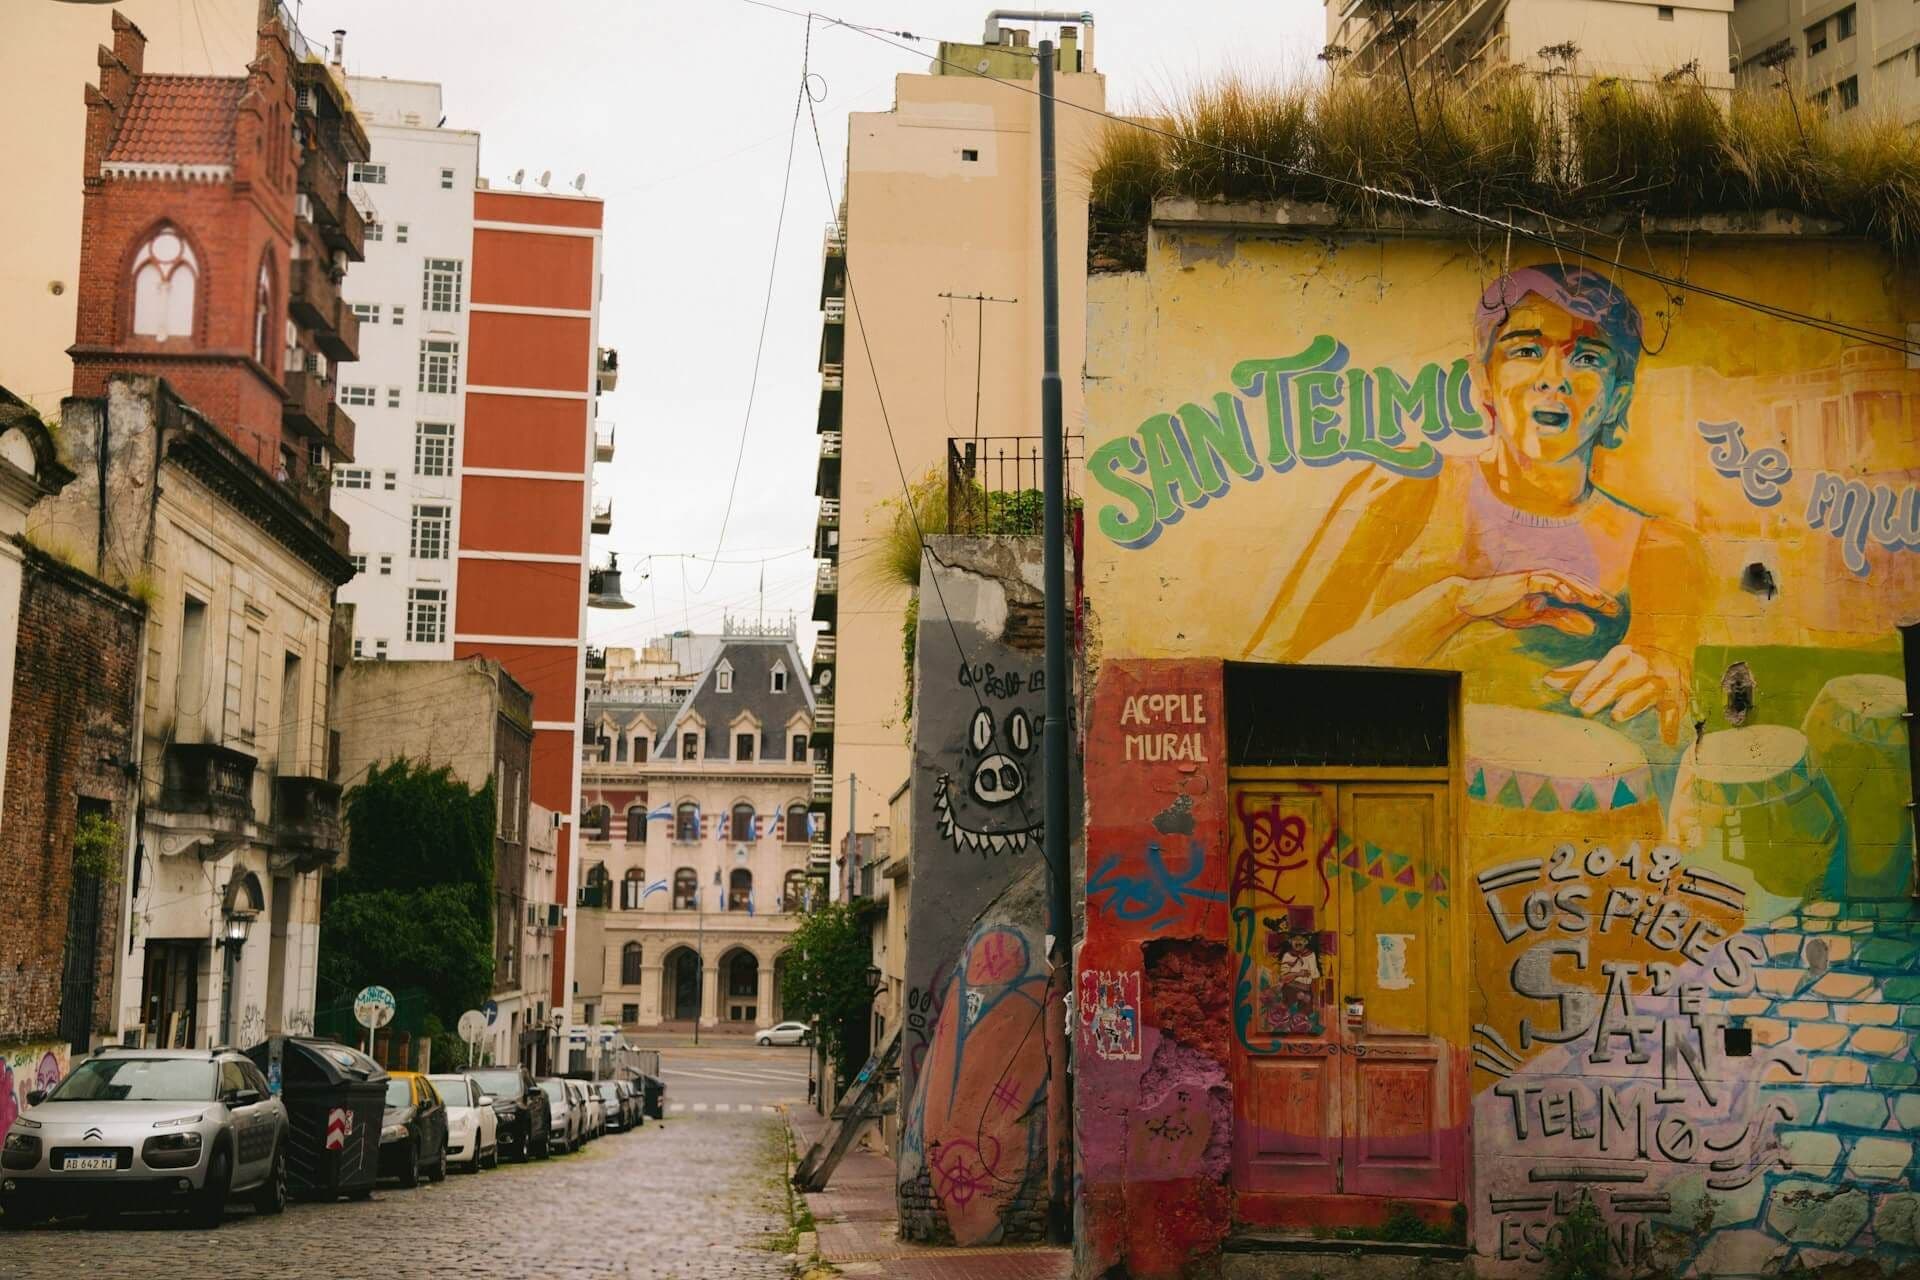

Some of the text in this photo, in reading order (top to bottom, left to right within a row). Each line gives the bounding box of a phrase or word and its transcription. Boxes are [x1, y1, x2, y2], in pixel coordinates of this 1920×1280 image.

[1087, 391, 1265, 551] SAN
[1120, 693, 1207, 726] ACOPLE
[1125, 733, 1209, 763] MURAL
[1548, 843, 1682, 883] 2018
[1486, 884, 1593, 944] LOS
[1510, 936, 1729, 1107] SAN
[1494, 1083, 1697, 1163] TELMO
[81, 1159, 99, 1169] 642
